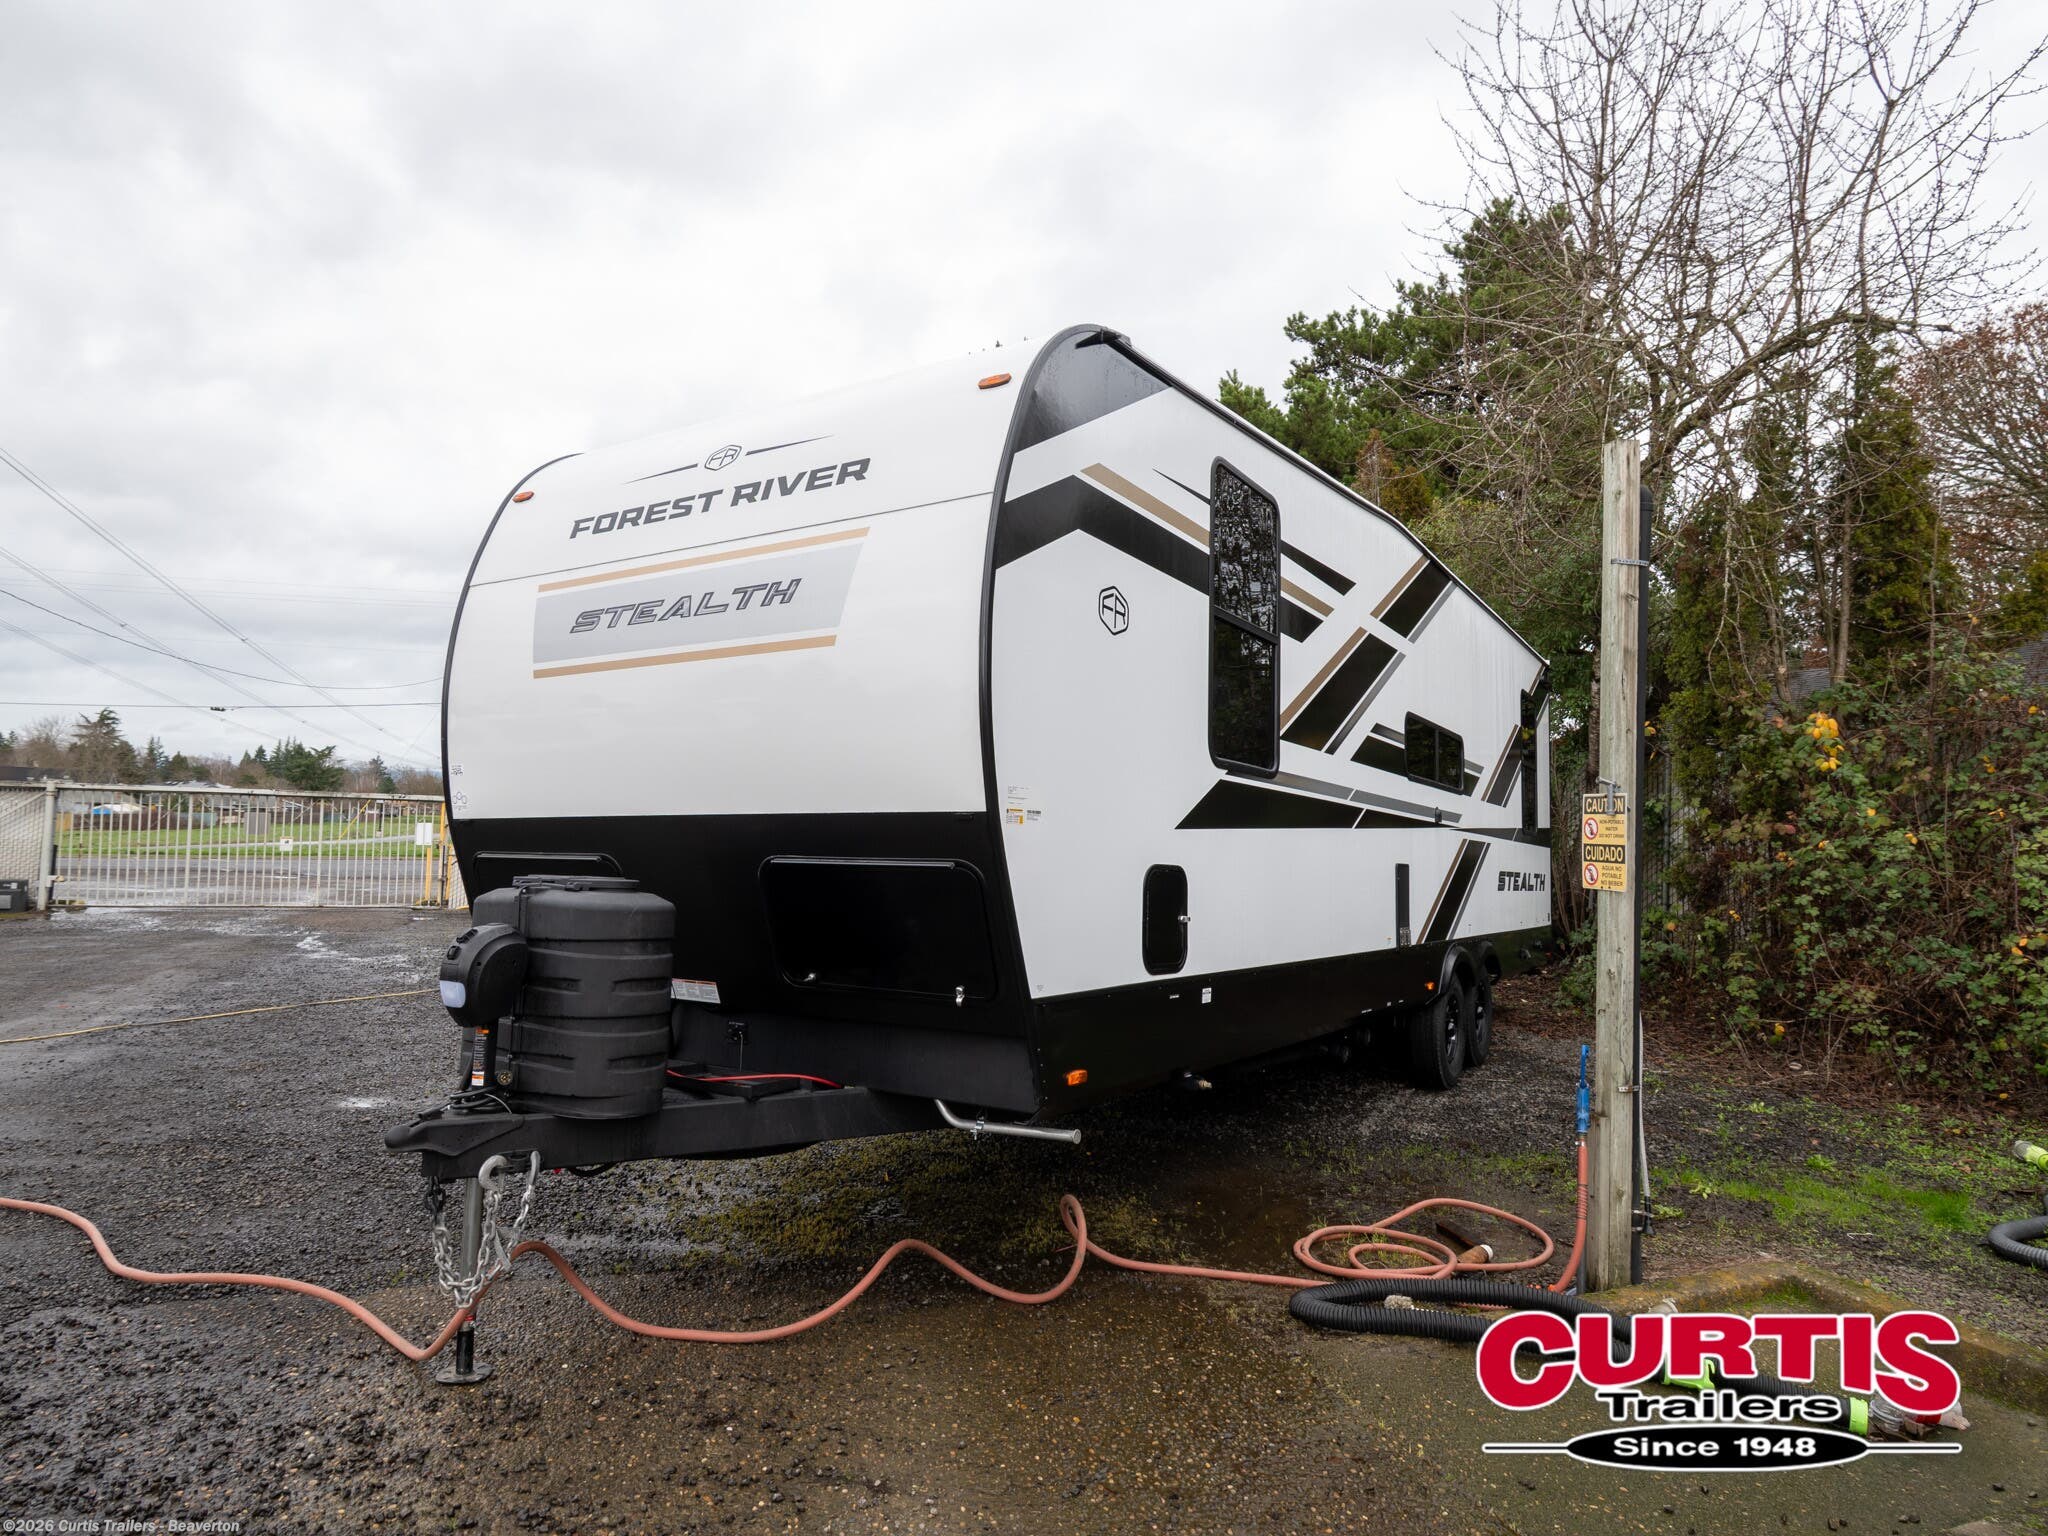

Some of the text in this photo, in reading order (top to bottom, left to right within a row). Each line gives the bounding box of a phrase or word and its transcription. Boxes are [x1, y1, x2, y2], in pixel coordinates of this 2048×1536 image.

[569, 457, 871, 539] FOREST RIVER
[569, 577, 802, 634] STEALTH
[1585, 798, 1624, 813] CAUTON
[1585, 845, 1624, 862] CUIDADO
[1498, 871, 1545, 891] STEALTH
